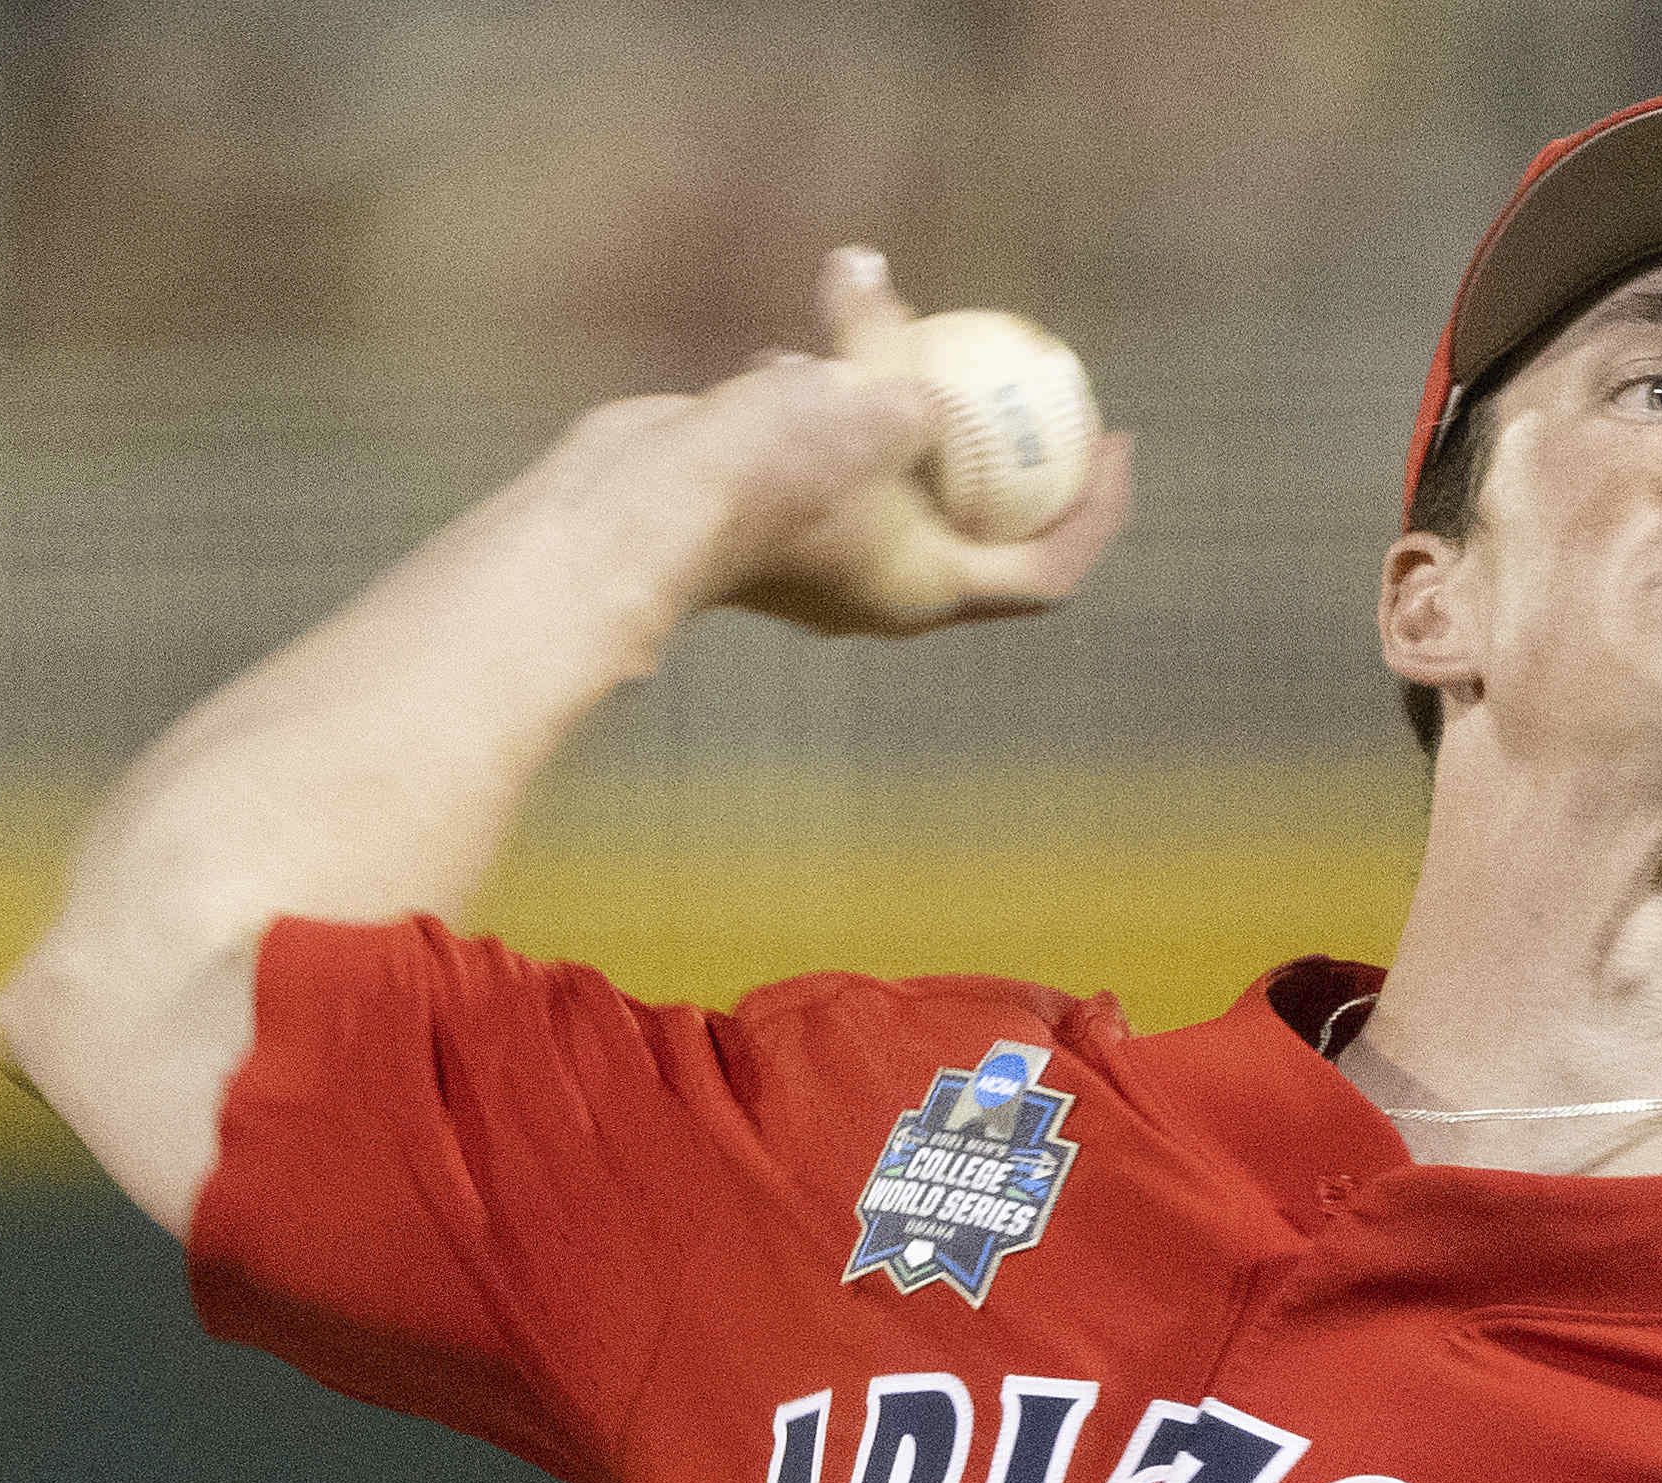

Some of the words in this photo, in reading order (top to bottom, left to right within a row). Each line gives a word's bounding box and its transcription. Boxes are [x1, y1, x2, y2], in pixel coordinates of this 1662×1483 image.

[904, 1147, 1015, 1194] COLLEGE
[863, 1176, 946, 1217] WORLD
[937, 1189, 1038, 1236] SERIES
